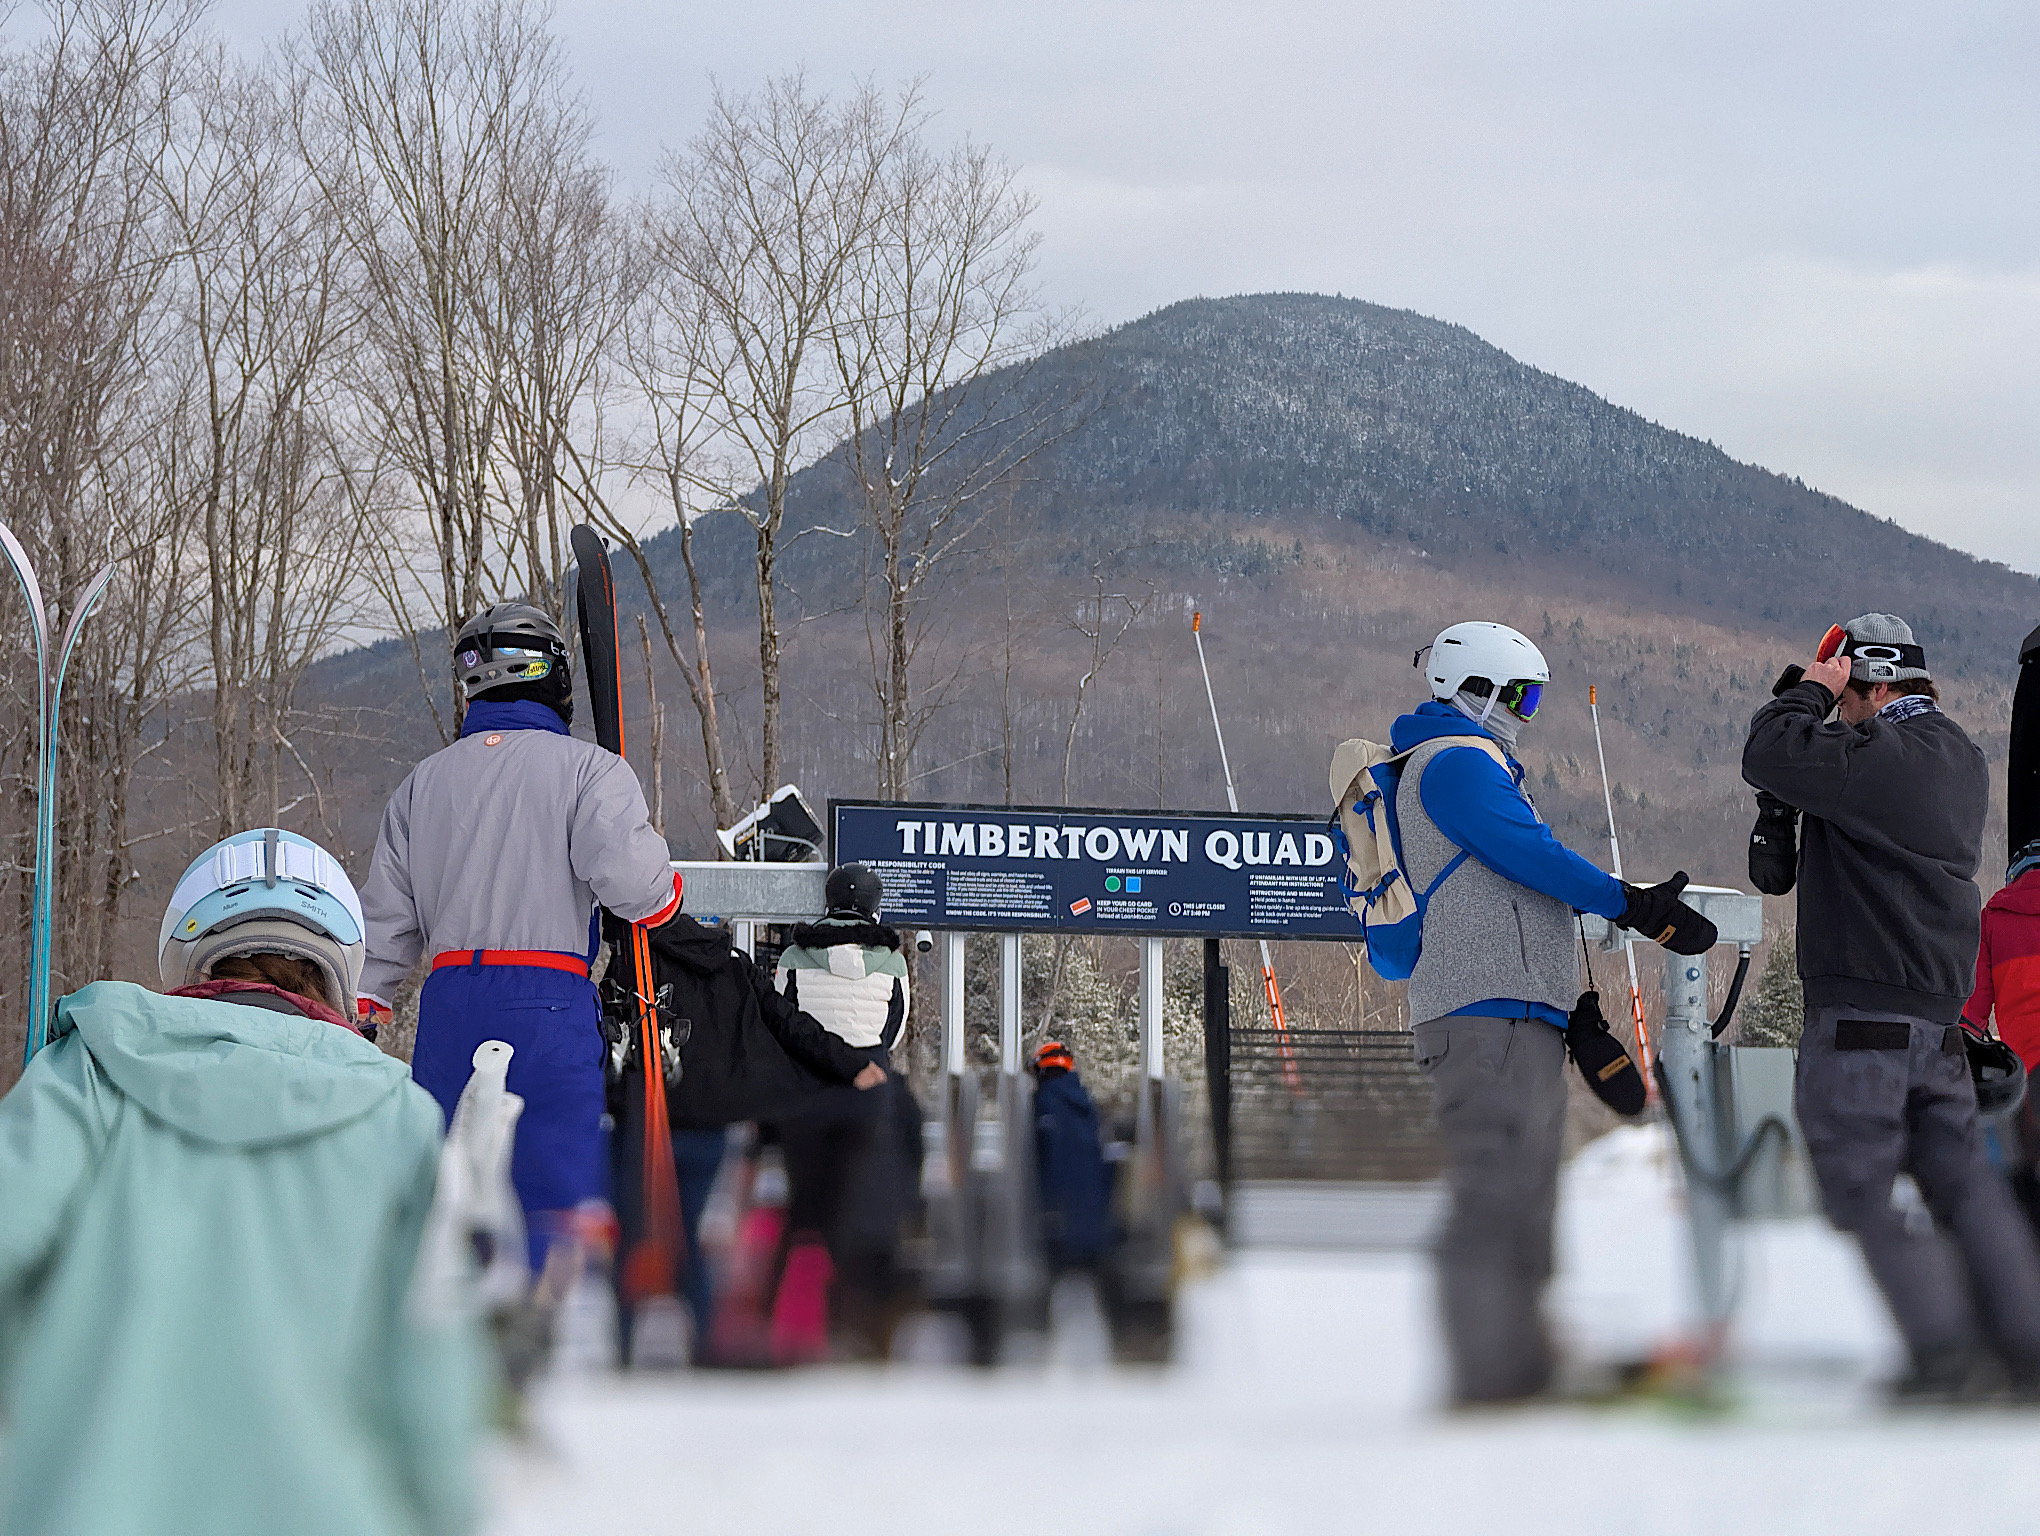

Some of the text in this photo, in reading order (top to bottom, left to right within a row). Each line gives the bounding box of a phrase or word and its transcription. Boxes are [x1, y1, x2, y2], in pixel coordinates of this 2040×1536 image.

[897, 821, 1333, 869] TIMBERTOWN QUAD
[223, 902, 238, 911] Allure
[300, 900, 328, 918] SMITH
